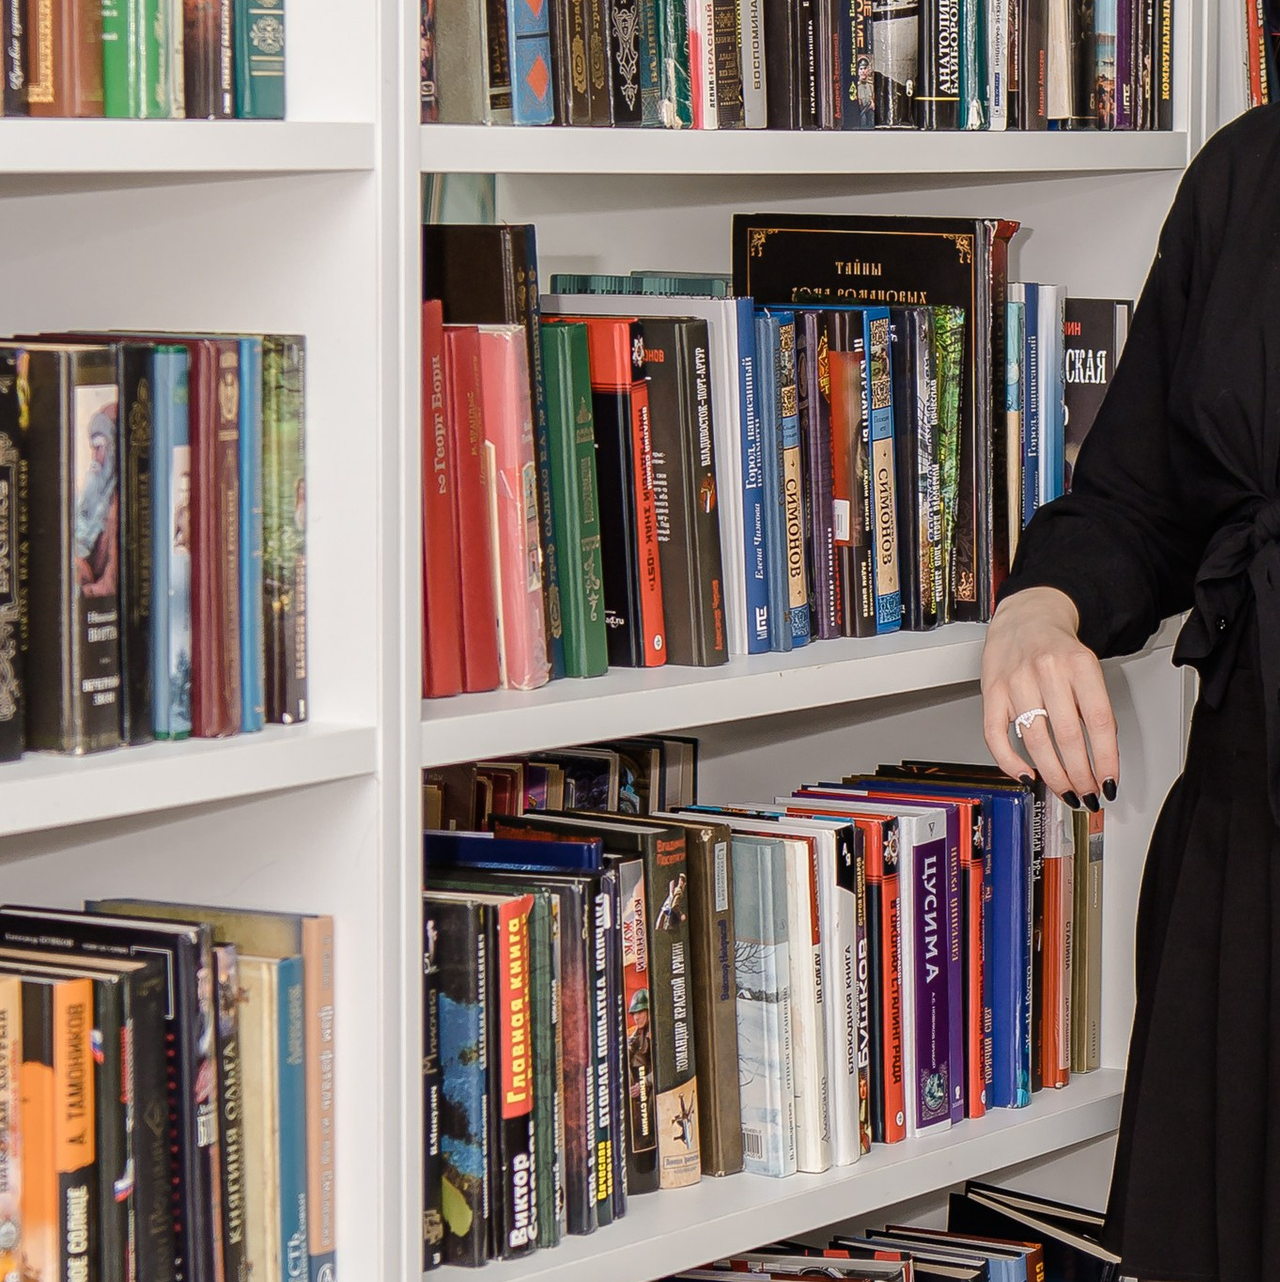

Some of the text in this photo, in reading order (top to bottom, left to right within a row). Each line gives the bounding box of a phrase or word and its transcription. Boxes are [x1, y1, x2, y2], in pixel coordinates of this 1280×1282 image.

[704, 3, 714, 77] КРАСНЫЙ
[834, 258, 884, 277] ТАЙНЫ
[429, 354, 447, 474] Георг Борн
[740, 356, 756, 440] написанный
[1025, 335, 1038, 415] написанный
[643, 454, 653, 491] СЕМИН
[876, 467, 892, 566] СИМОНОВ
[643, 506, 654, 545] ЗНАК
[751, 501, 765, 580] Елена Чижова
[784, 477, 801, 579] СИМОНОВ
[1031, 800, 1043, 852] КРЕПОСТЬ
[634, 898, 646, 973] КРАСНЫЙ
[921, 854, 941, 984] ЦУСИМА
[948, 845, 960, 963] ЕВГЕНИЙ РУБИН
[1064, 920, 1072, 971] СТАЛИНА
[716, 919, 732, 1001] Виктор Некрасов
[505, 919, 528, 1105] Главная книга
[670, 941, 692, 1073] КОМАНДИР КРАСНОЙ АРМИИ
[843, 945, 854, 1076] БЛОКАДНАЯ КНИГА
[890, 978, 903, 1085] СТАЛИНГРАДА
[982, 1006, 994, 1085] ГОРЯЧИЙ СНЕГ
[64, 1003, 85, 1119] ТАМОНИКОВ
[596, 976, 610, 1130] ВТОРАЯ ПОПЫТКА
[221, 1041, 244, 1246] КНЯГИНЯ ОЛЬГА
[65, 1186, 87, 1255] СОЛНЦЕ
[508, 1154, 530, 1248] Виктор
